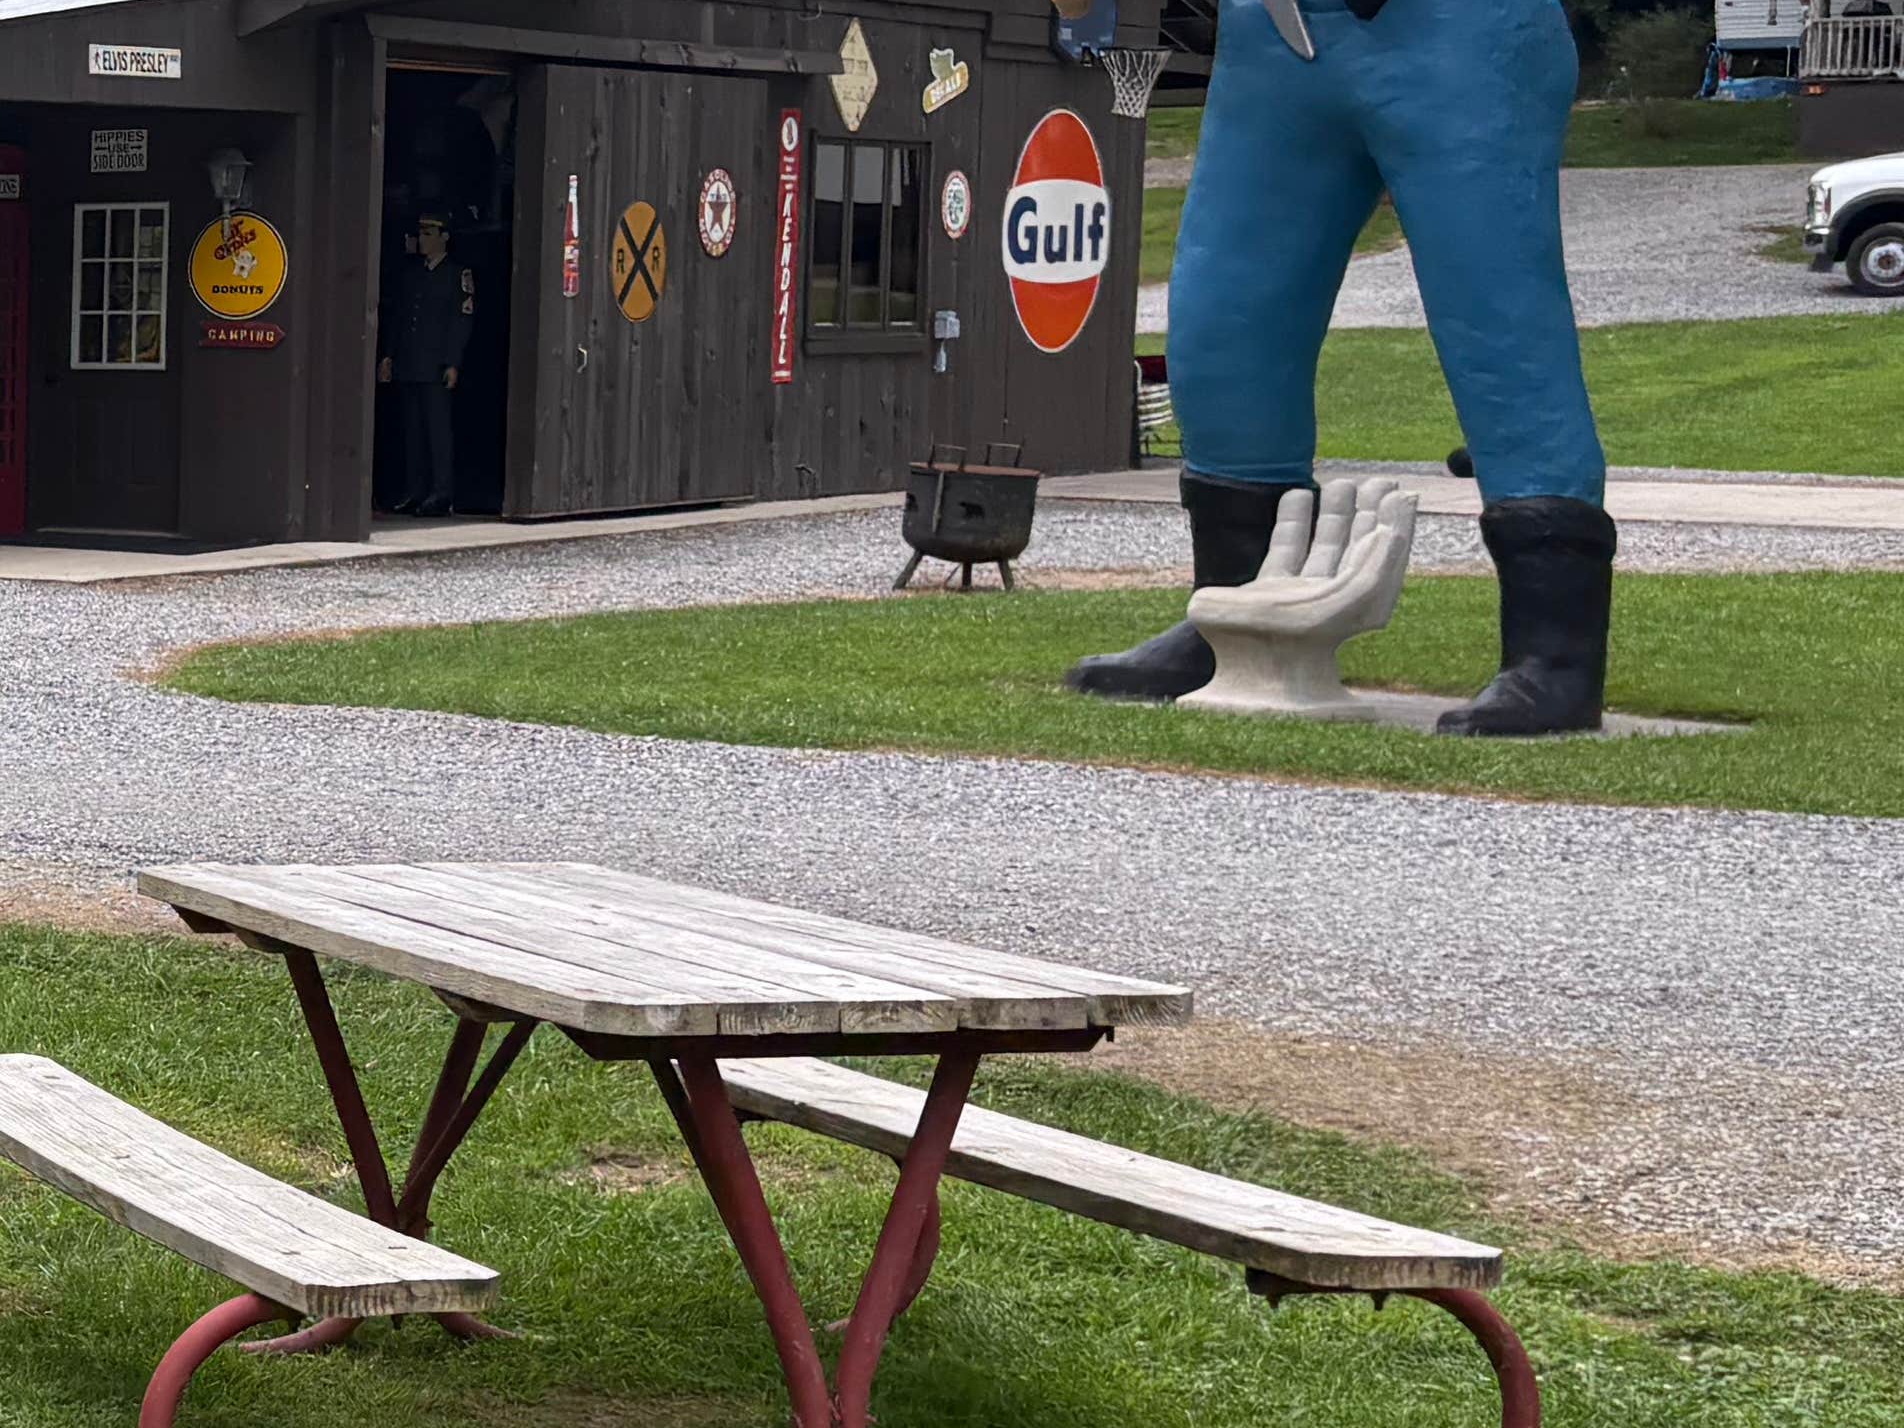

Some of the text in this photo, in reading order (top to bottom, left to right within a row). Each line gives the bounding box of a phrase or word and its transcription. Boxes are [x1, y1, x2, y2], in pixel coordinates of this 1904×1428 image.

[102, 50, 128, 72] ELVIS
[130, 52, 168, 73] PRESLEY
[95, 131, 145, 142] HIPPIES
[108, 143, 130, 153] USE
[94, 153, 144, 170] SIDE DOOR
[1007, 195, 1106, 265] Gulf
[778, 191, 794, 364] KENDALL
[211, 284, 265, 295] DONUTS
[207, 328, 275, 344] CAMPING
